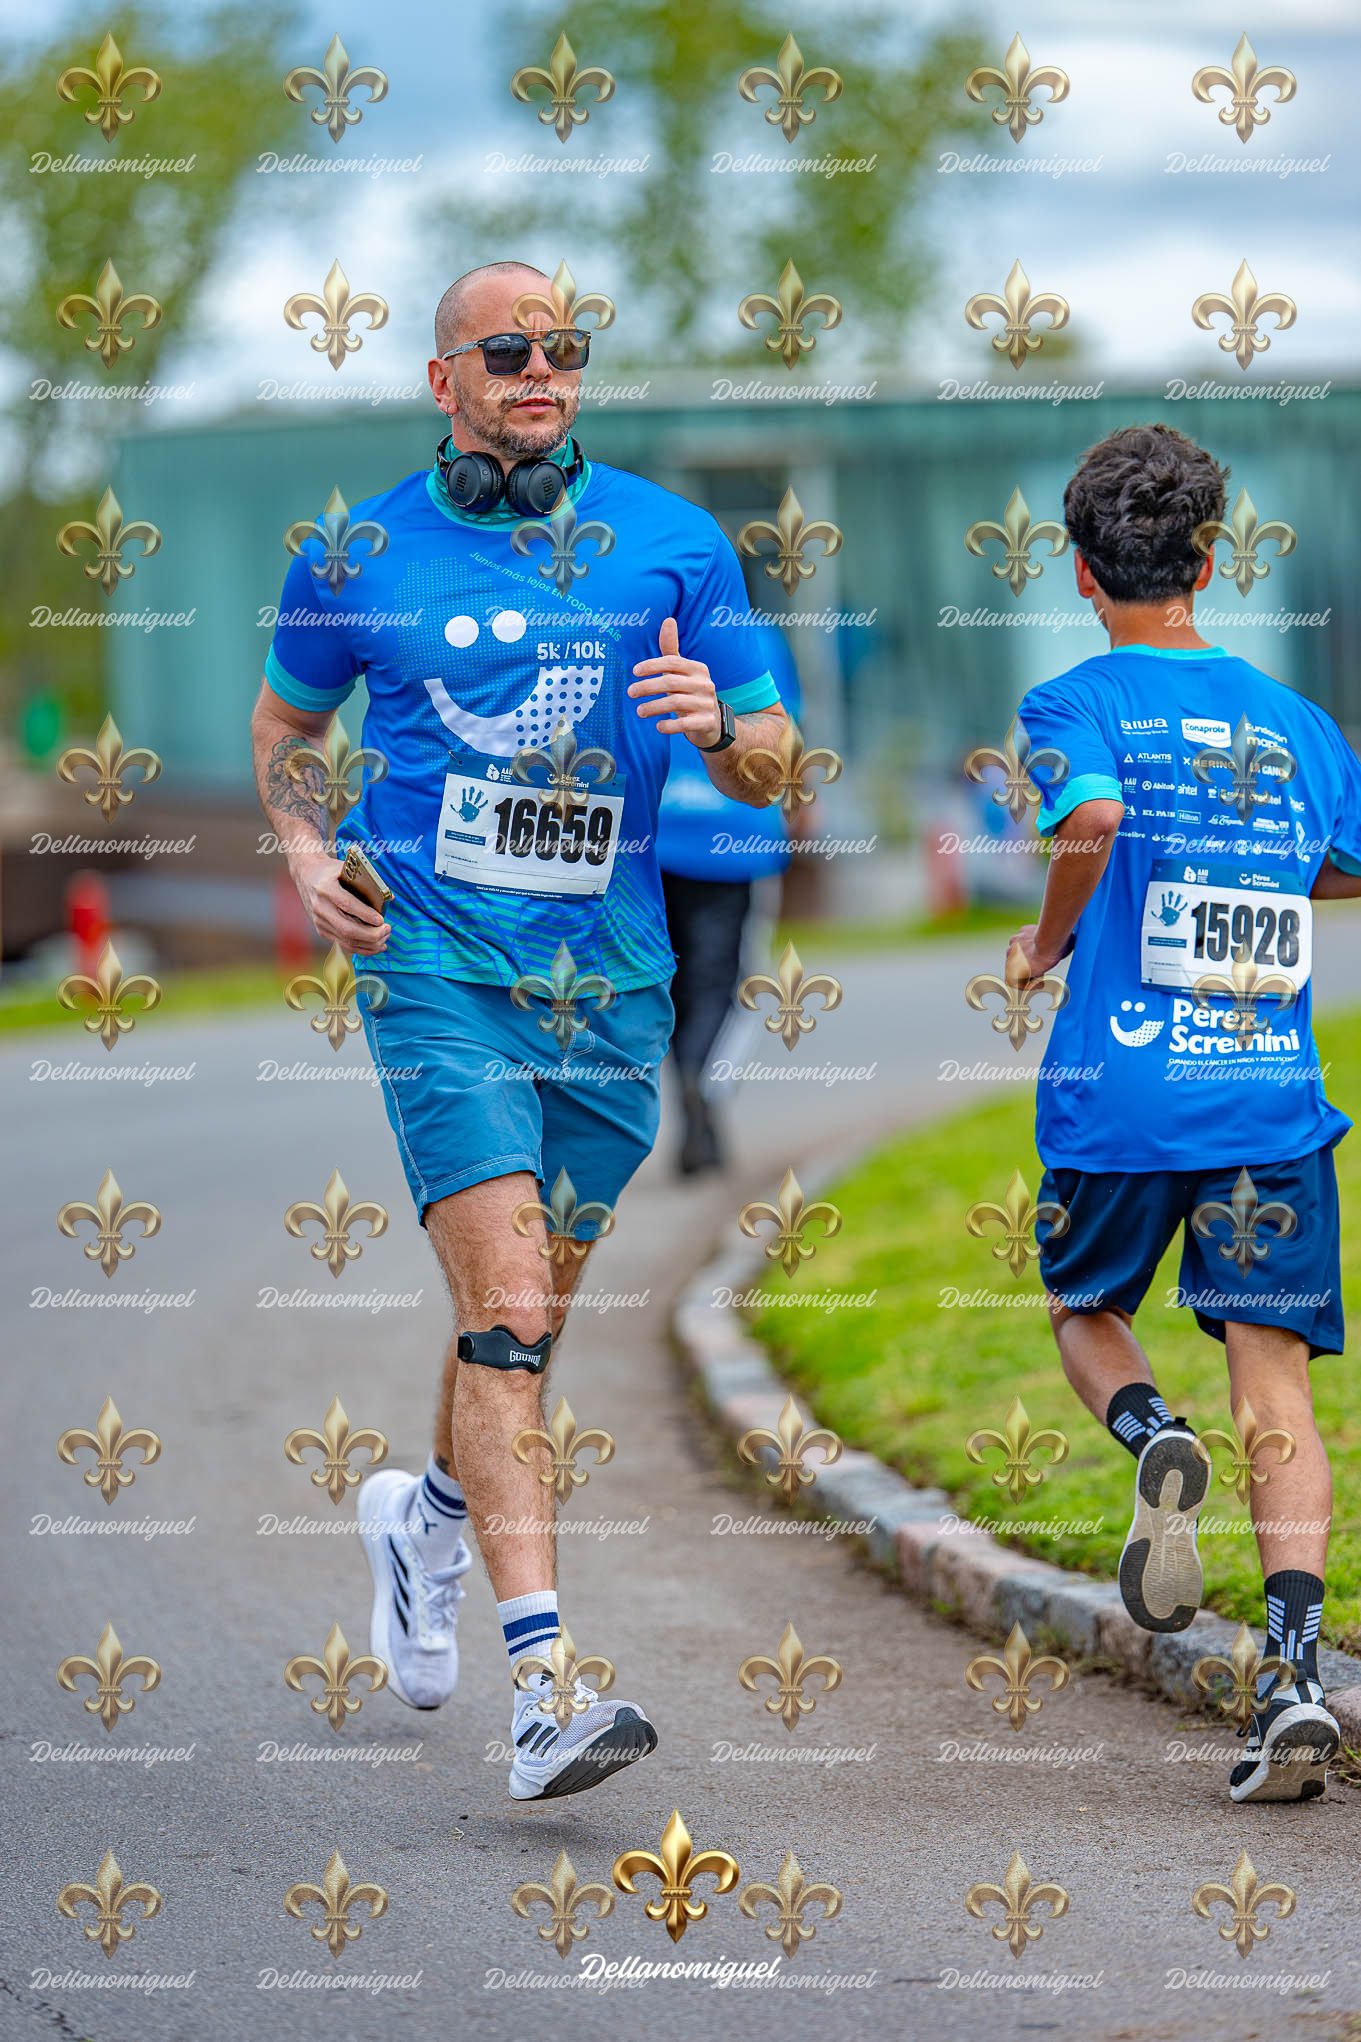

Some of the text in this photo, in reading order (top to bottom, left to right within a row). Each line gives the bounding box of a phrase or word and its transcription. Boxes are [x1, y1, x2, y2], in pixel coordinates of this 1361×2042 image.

[551, 588, 564, 599] EN
[566, 594, 593, 616] TODO
[1120, 718, 1169, 730] aiwa
[1137, 752, 1172, 761] ATLANTIS
[1153, 782, 1176, 791] Abitab
[1177, 784, 1198, 796] antel
[1142, 809, 1154, 817] EL
[495, 797, 613, 866] 16659
[1191, 901, 1300, 968] 15928
[1168, 1025, 1300, 1055] Scremini
